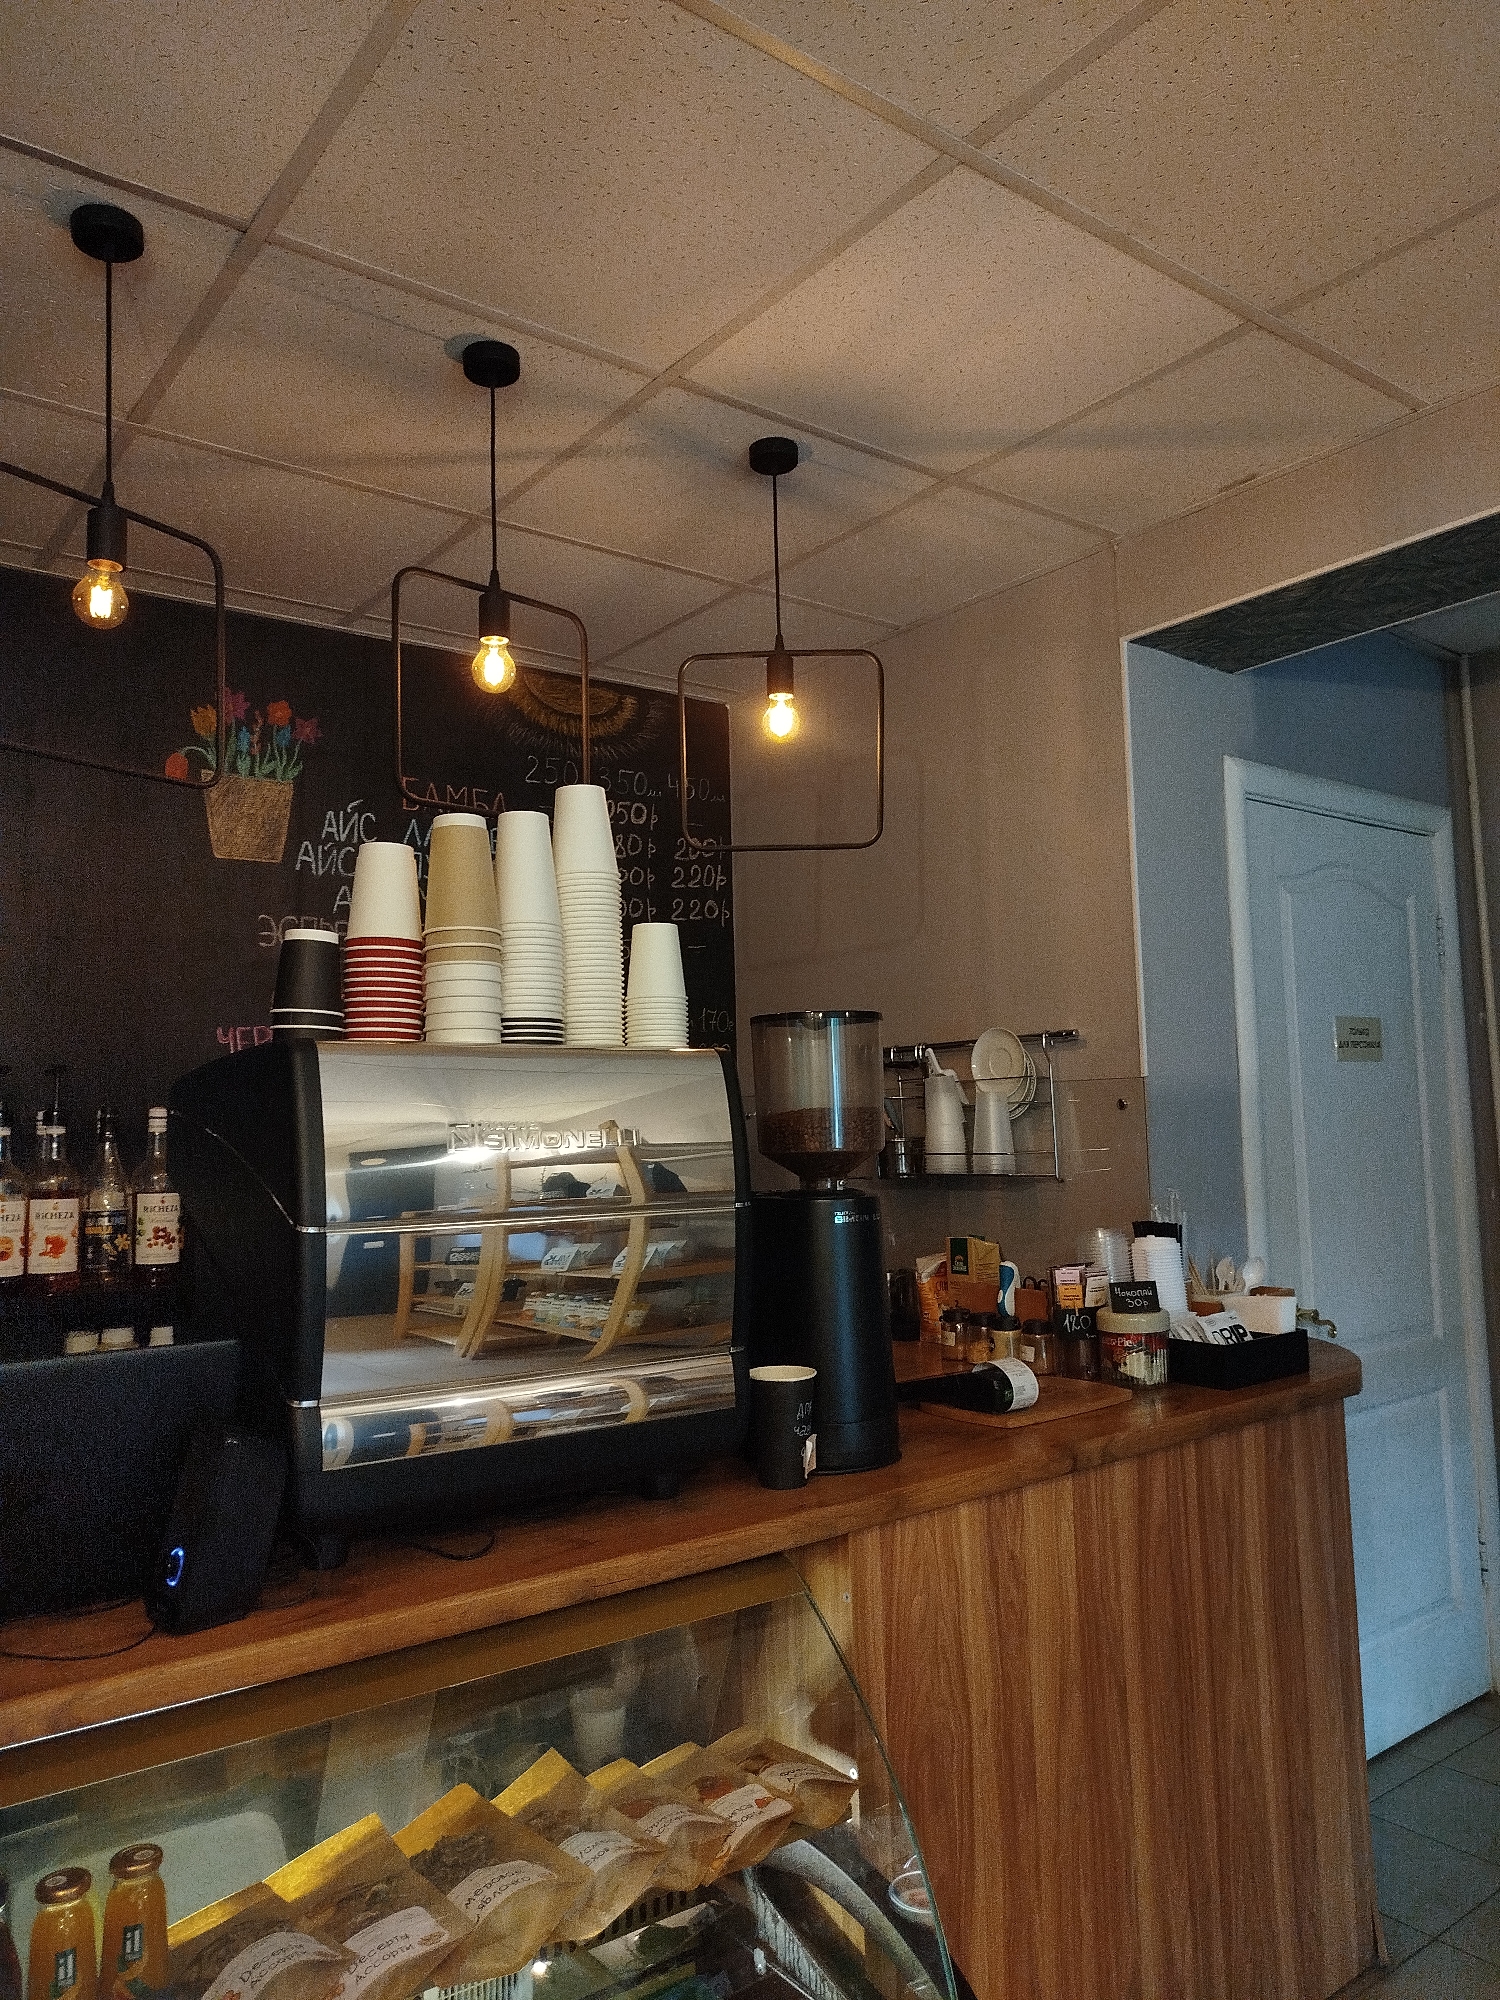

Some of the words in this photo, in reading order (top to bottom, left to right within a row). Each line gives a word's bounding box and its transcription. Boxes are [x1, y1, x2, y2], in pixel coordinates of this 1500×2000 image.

[525, 756, 578, 785] 250
[321, 800, 378, 845] АЙС
[295, 840, 355, 877] АЙС
[671, 865, 727, 891] 220р
[671, 898, 730, 928] 220р
[1063, 1315, 1091, 1334] 120
[1212, 1324, 1248, 1345] DRIP
